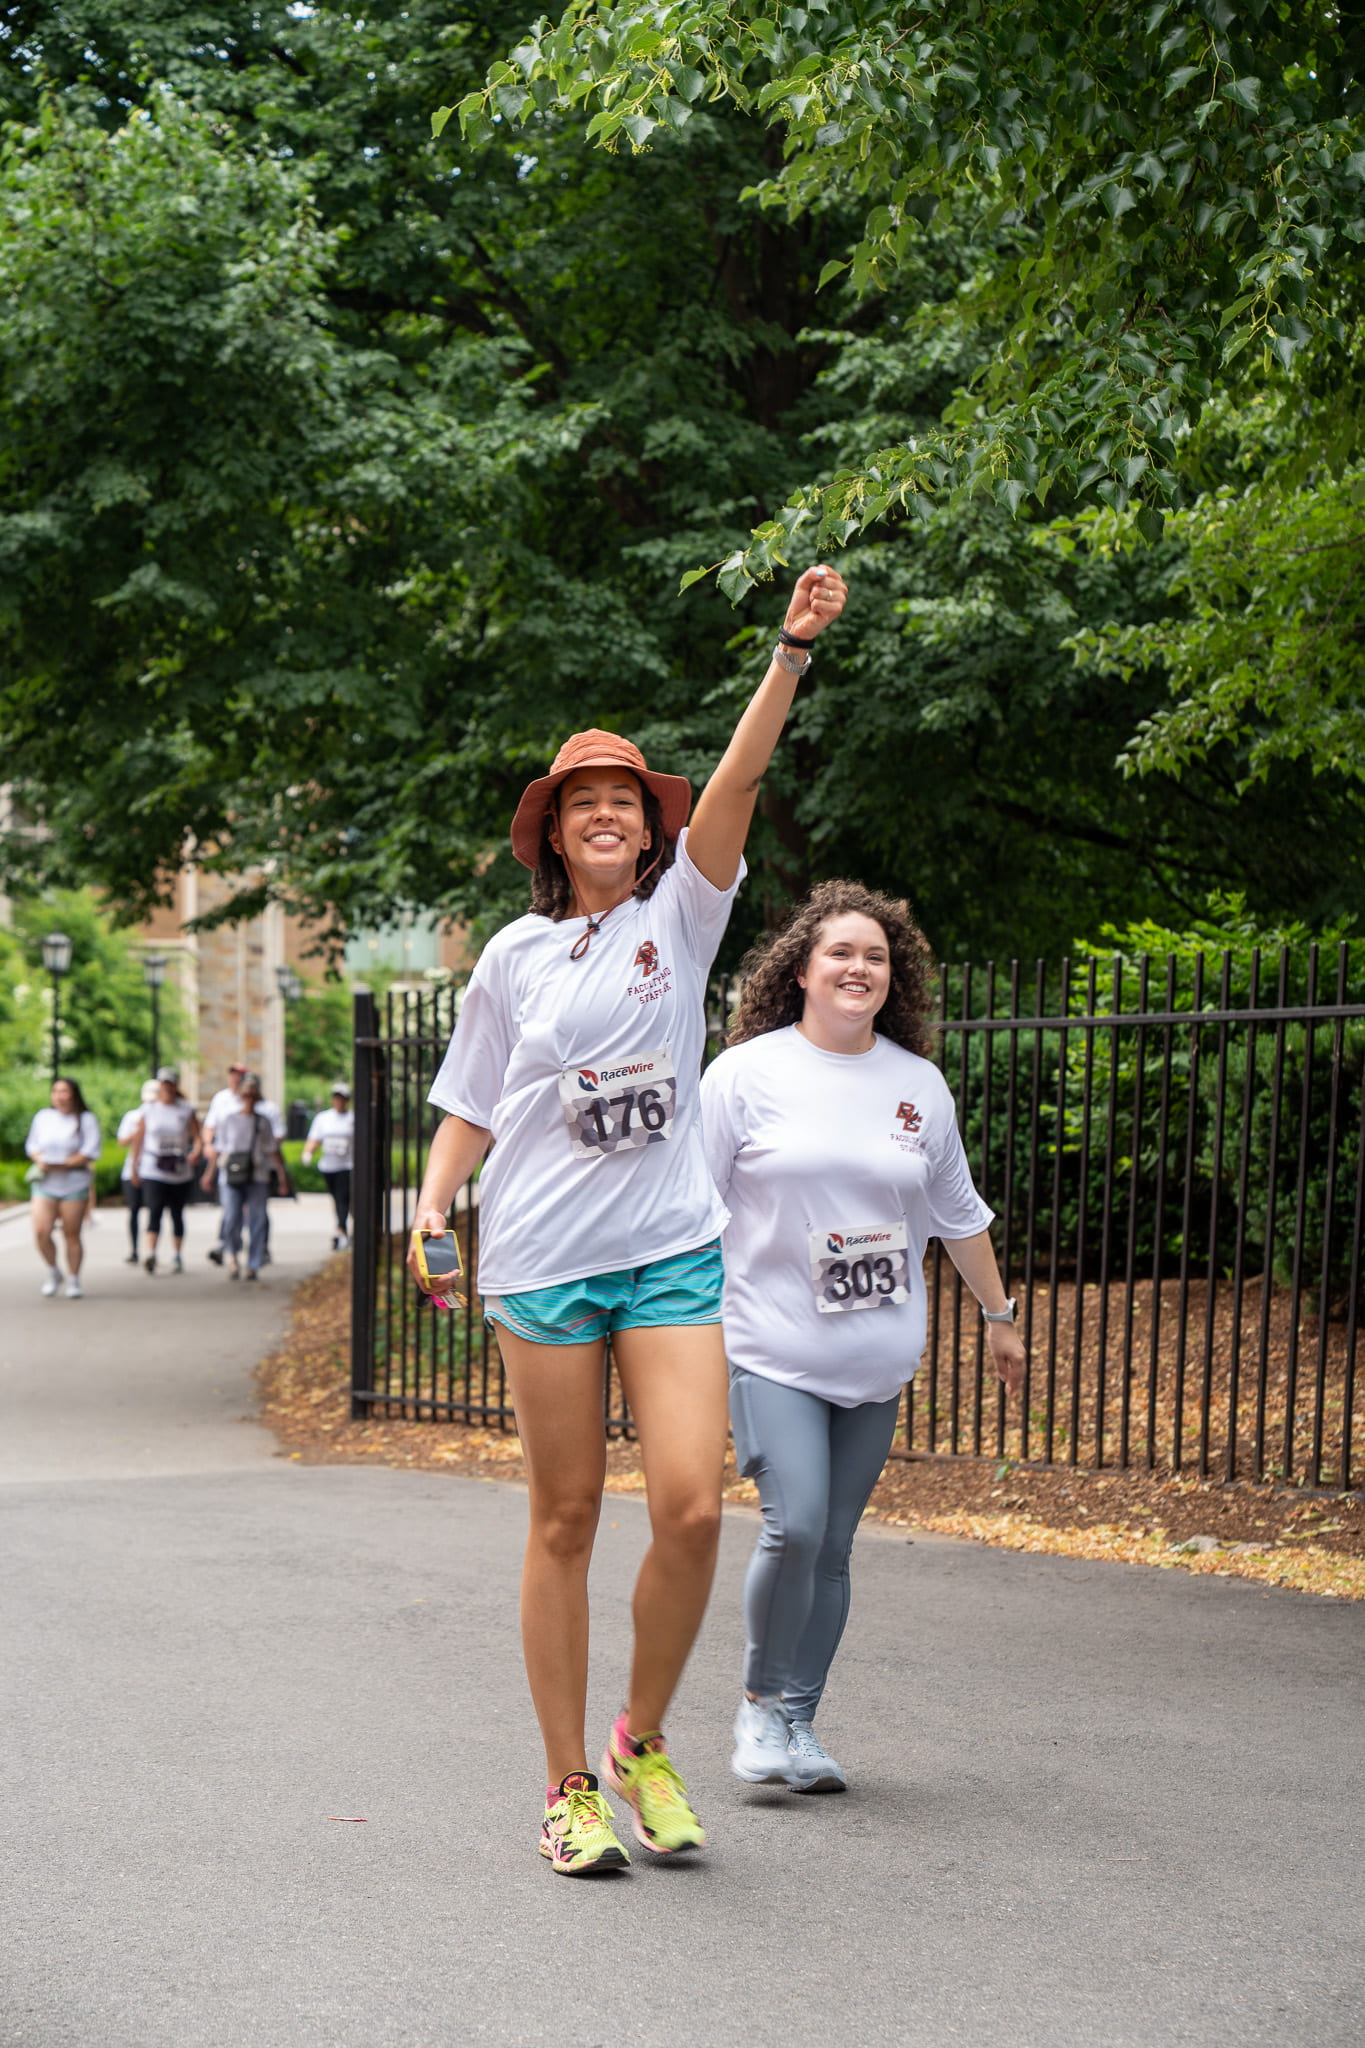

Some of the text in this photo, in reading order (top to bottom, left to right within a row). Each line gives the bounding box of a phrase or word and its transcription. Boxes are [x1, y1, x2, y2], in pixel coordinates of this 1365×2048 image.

[639, 988, 663, 1005] STAFF
[600, 1063, 654, 1082] RaceWire
[585, 1089, 666, 1142] 176
[845, 1233, 892, 1247] RaceWire
[828, 1257, 896, 1301] 303
